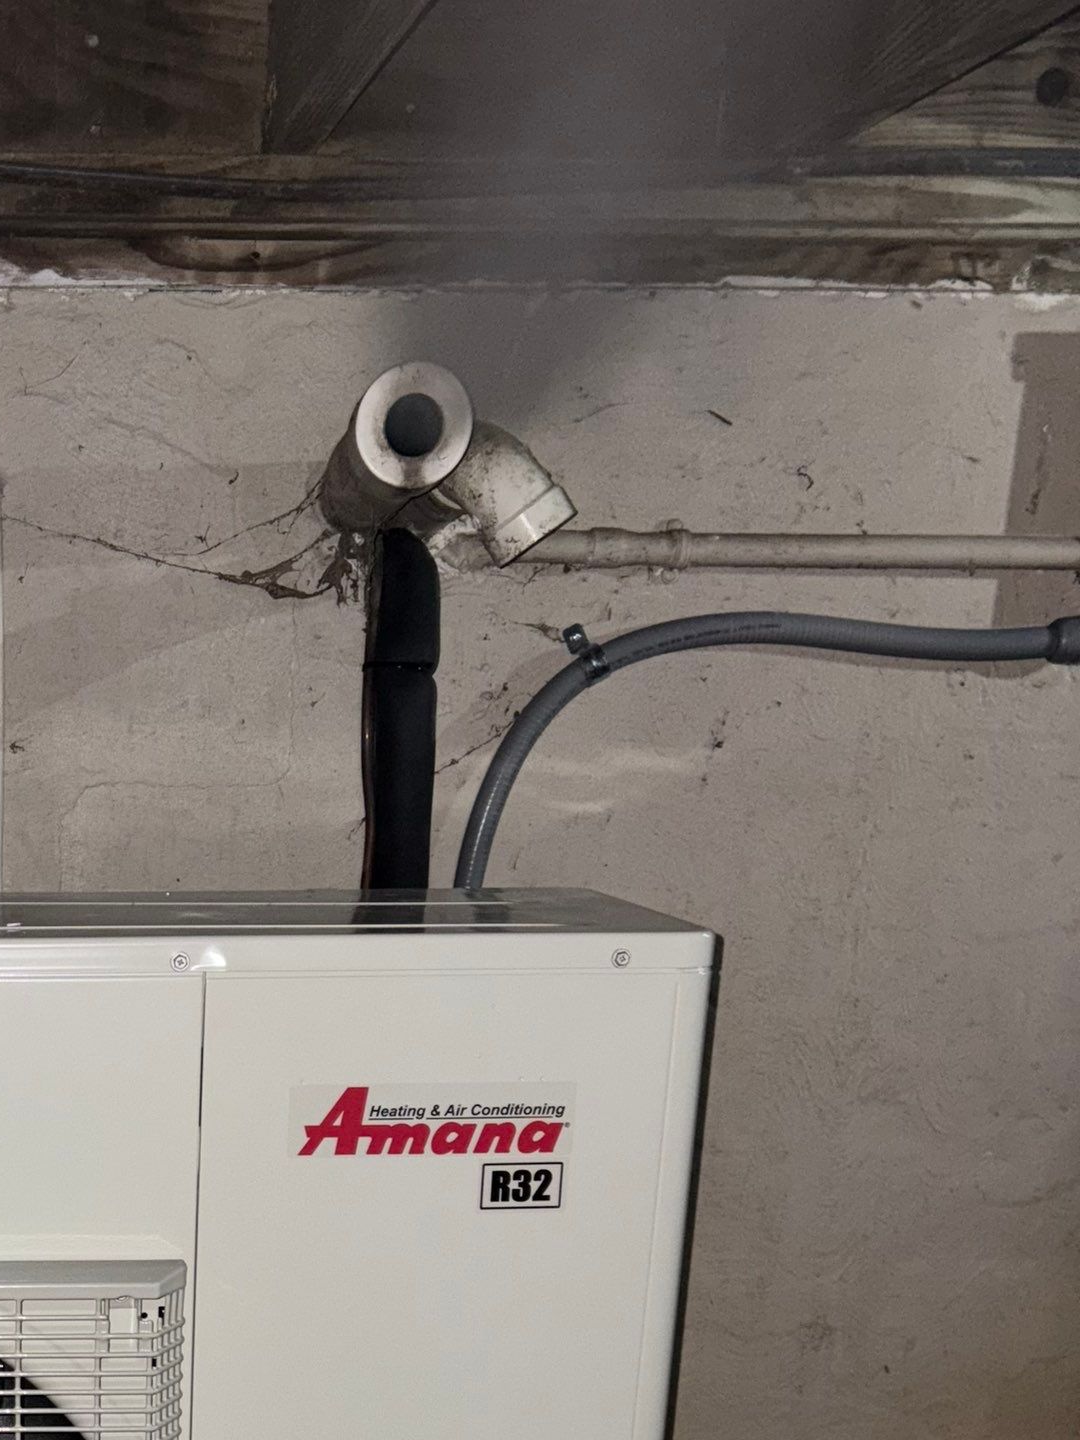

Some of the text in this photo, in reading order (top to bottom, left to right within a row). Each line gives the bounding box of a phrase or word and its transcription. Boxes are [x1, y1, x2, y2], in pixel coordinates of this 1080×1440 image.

[297, 1086, 565, 1156] Amana
[369, 1103, 566, 1120] Heating & Air Conditioning
[490, 1168, 553, 1203] R32
